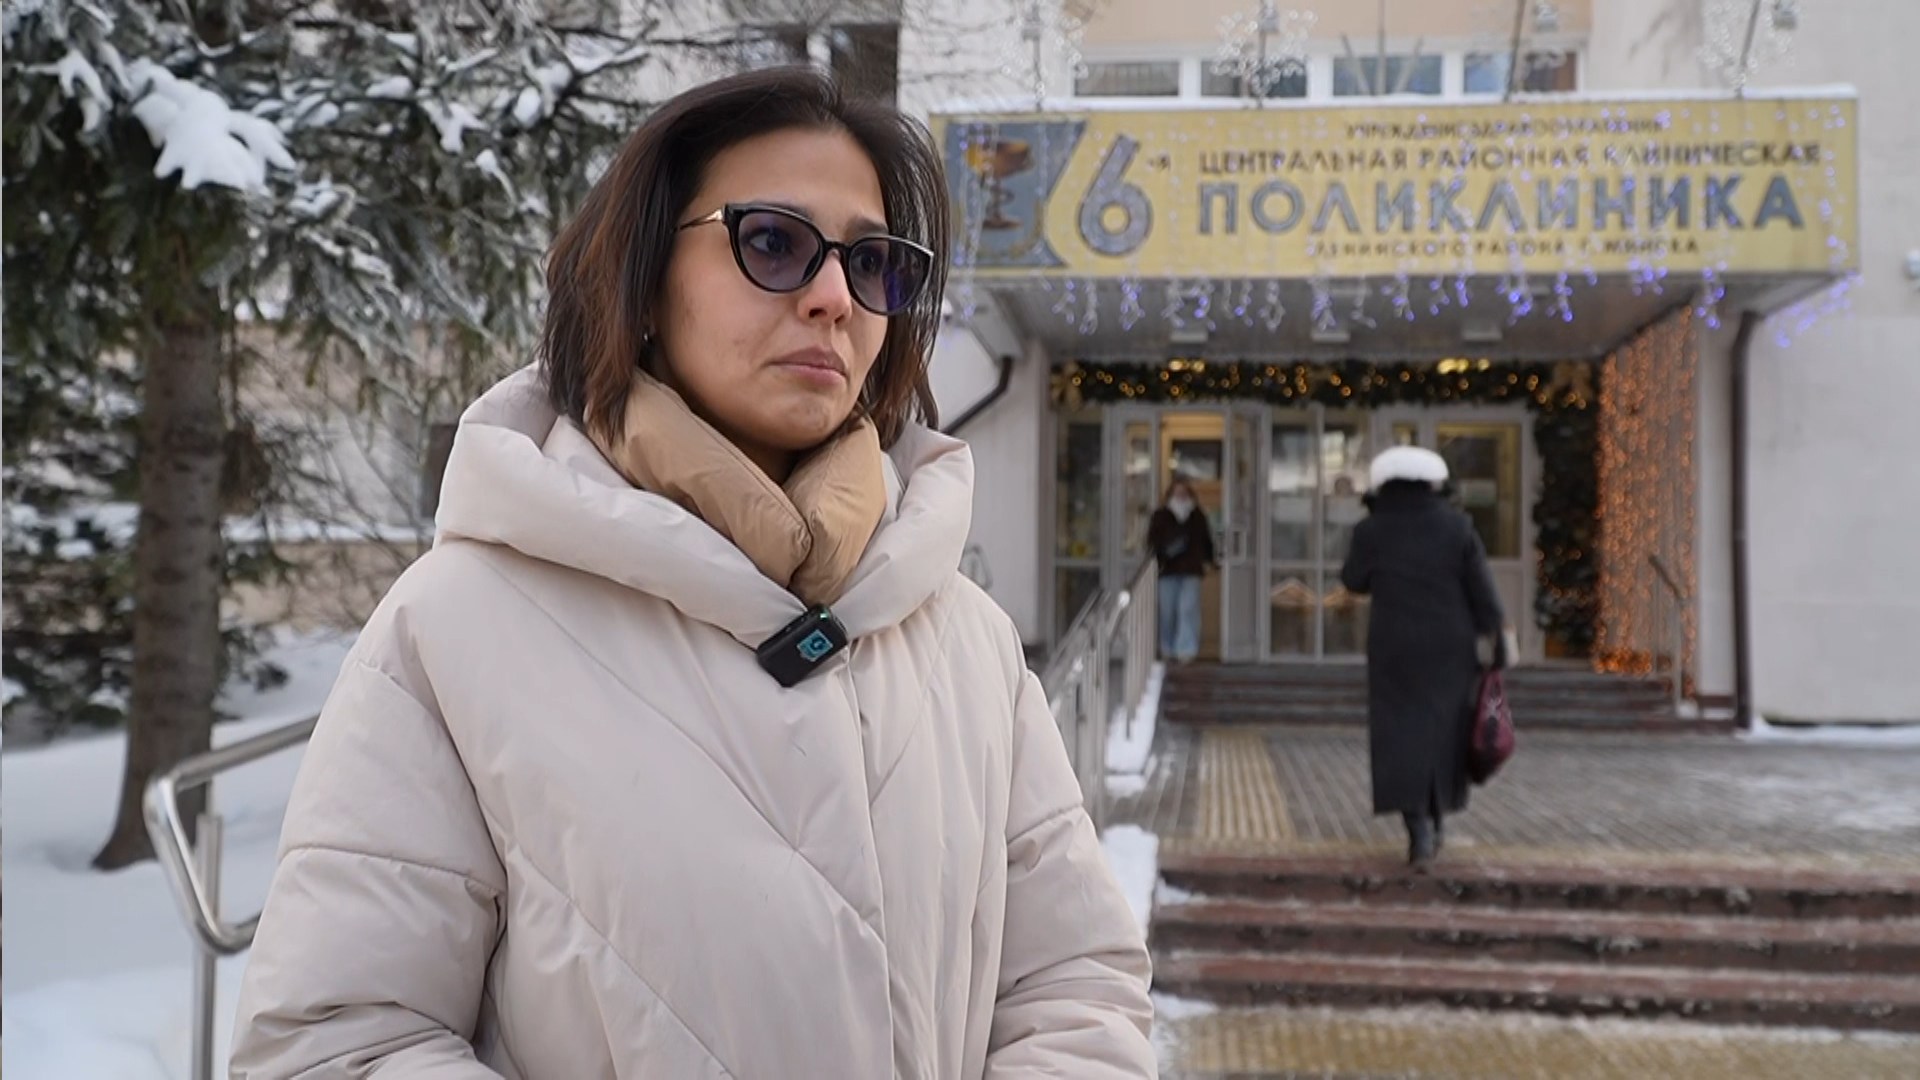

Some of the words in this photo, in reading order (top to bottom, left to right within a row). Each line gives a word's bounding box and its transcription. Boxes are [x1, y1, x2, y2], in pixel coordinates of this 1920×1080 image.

[1200, 150, 1408, 174] ЦЕНТРАЛЬНАЯ
[1420, 147, 1589, 170] РАЙОННАЯ
[1604, 143, 1820, 167] КЛИНИЧЕСКАЯ
[1198, 176, 1806, 235] ПОЛИКЛИНИКА
